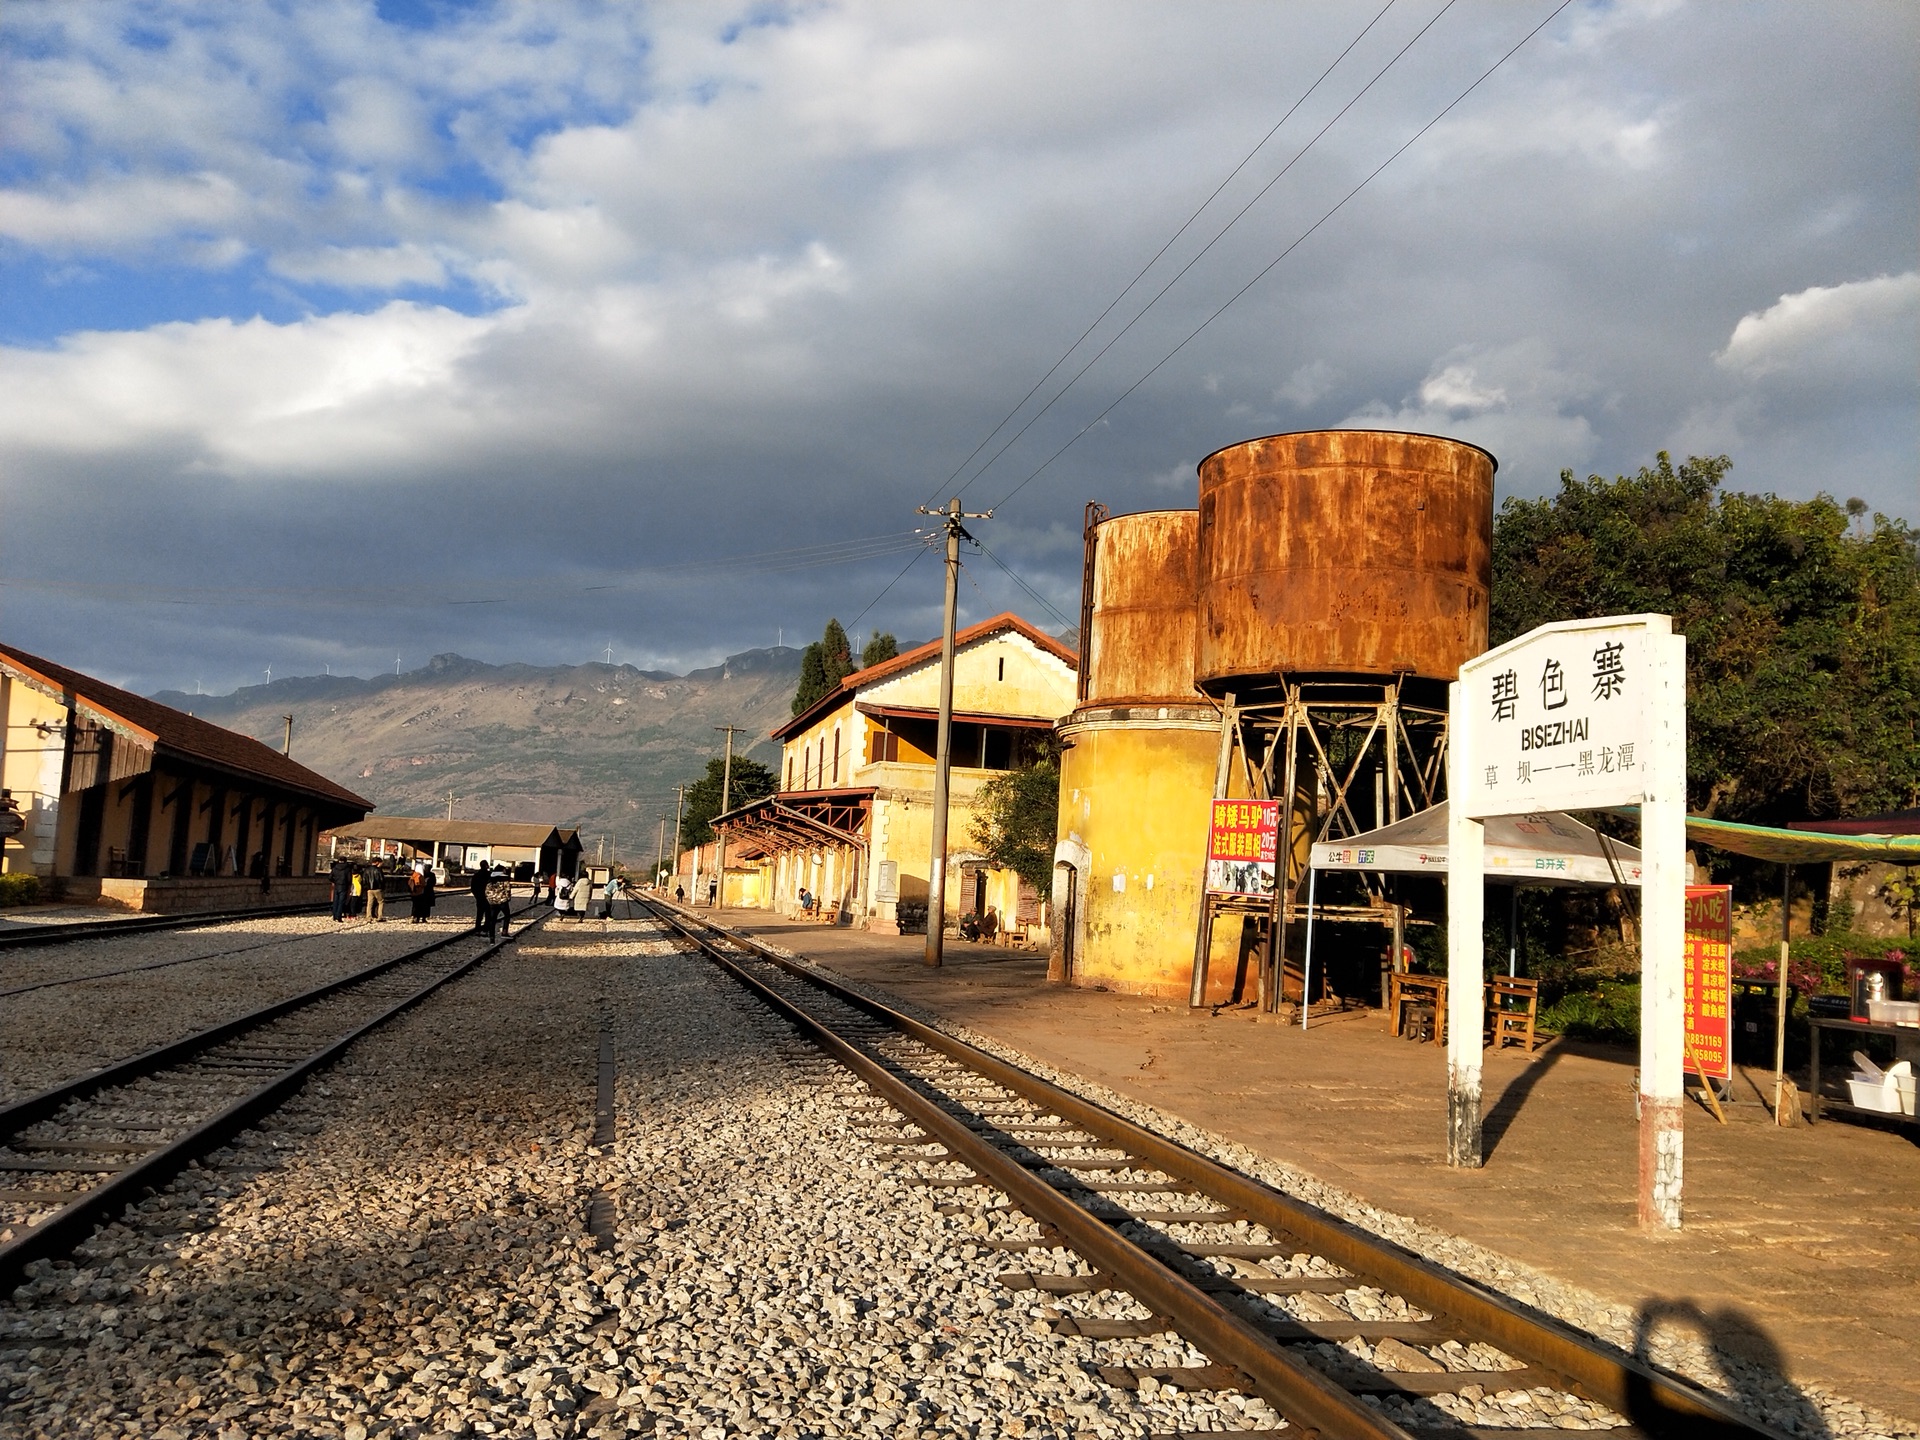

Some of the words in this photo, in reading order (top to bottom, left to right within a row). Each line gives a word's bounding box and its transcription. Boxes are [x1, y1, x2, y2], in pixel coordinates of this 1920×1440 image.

[1491, 641, 1627, 723] 碧色寨
[1521, 717, 1589, 751] BISEZHAI
[1484, 761, 1532, 790] 草坝
[1577, 742, 1636, 777] 黑龙潭
[1214, 804, 1263, 829] 骑矮马驴
[1262, 806, 1277, 828] 10元
[1213, 831, 1261, 858] 法式服装照相
[1261, 831, 1276, 850] 20元
[1702, 943, 1726, 957] 烤豆腐
[1702, 958, 1726, 972] 凉米线
[1702, 973, 1726, 989] 黑凉粉
[1702, 988, 1726, 1003] 冰稀饭
